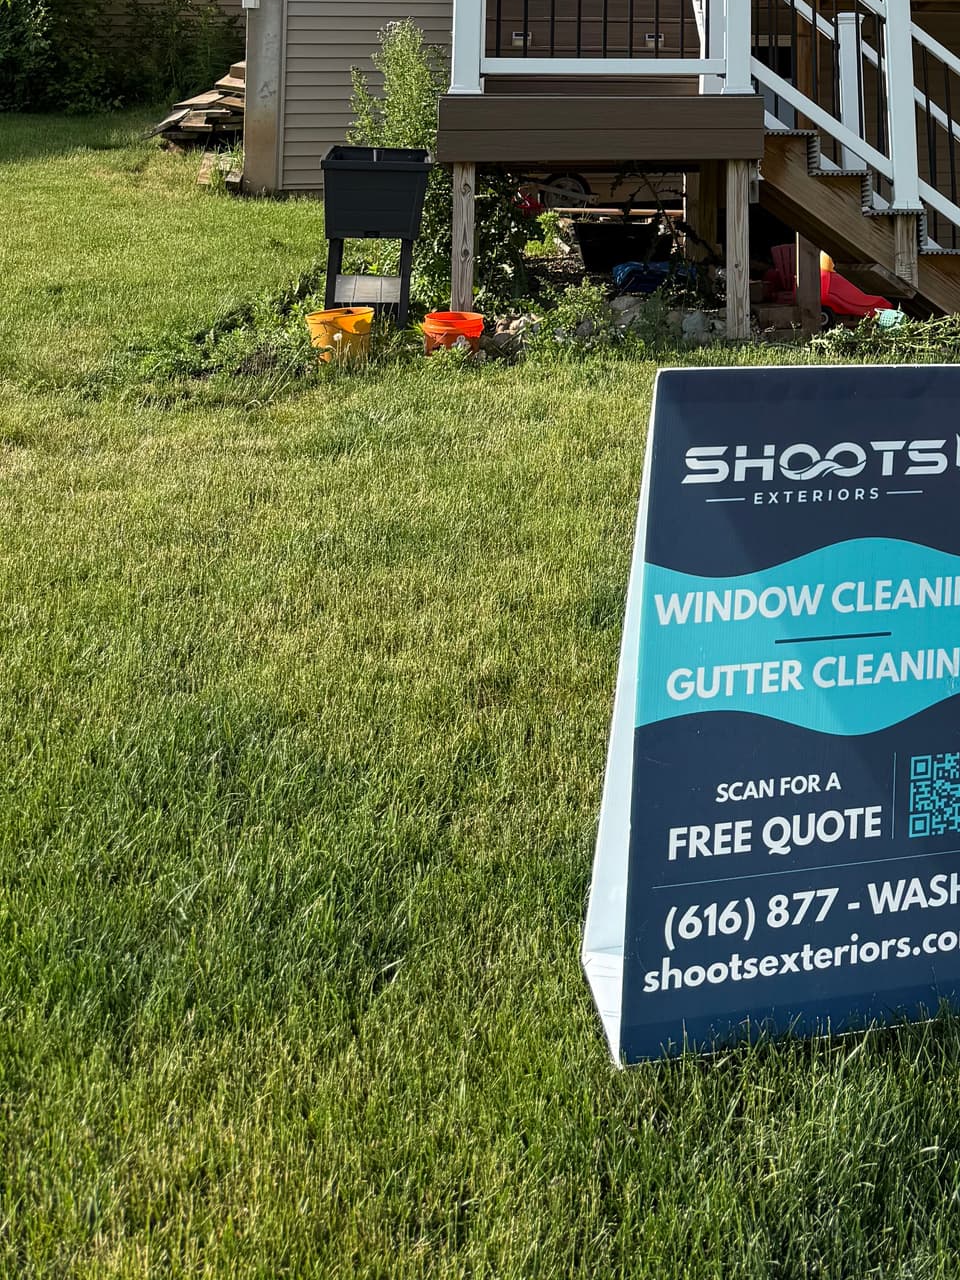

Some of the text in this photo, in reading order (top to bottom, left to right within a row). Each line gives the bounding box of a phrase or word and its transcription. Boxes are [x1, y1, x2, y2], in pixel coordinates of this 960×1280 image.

[681, 439, 947, 484] SHOOTS
[753, 487, 879, 505] EXTERIORS
[654, 583, 824, 626] WINDOW
[666, 659, 804, 701] GUTTER
[715, 771, 842, 803] SCAN FOR A
[668, 805, 882, 861] FREE QUOTE
[664, 897, 755, 951] (616)
[767, 887, 840, 928] 877
